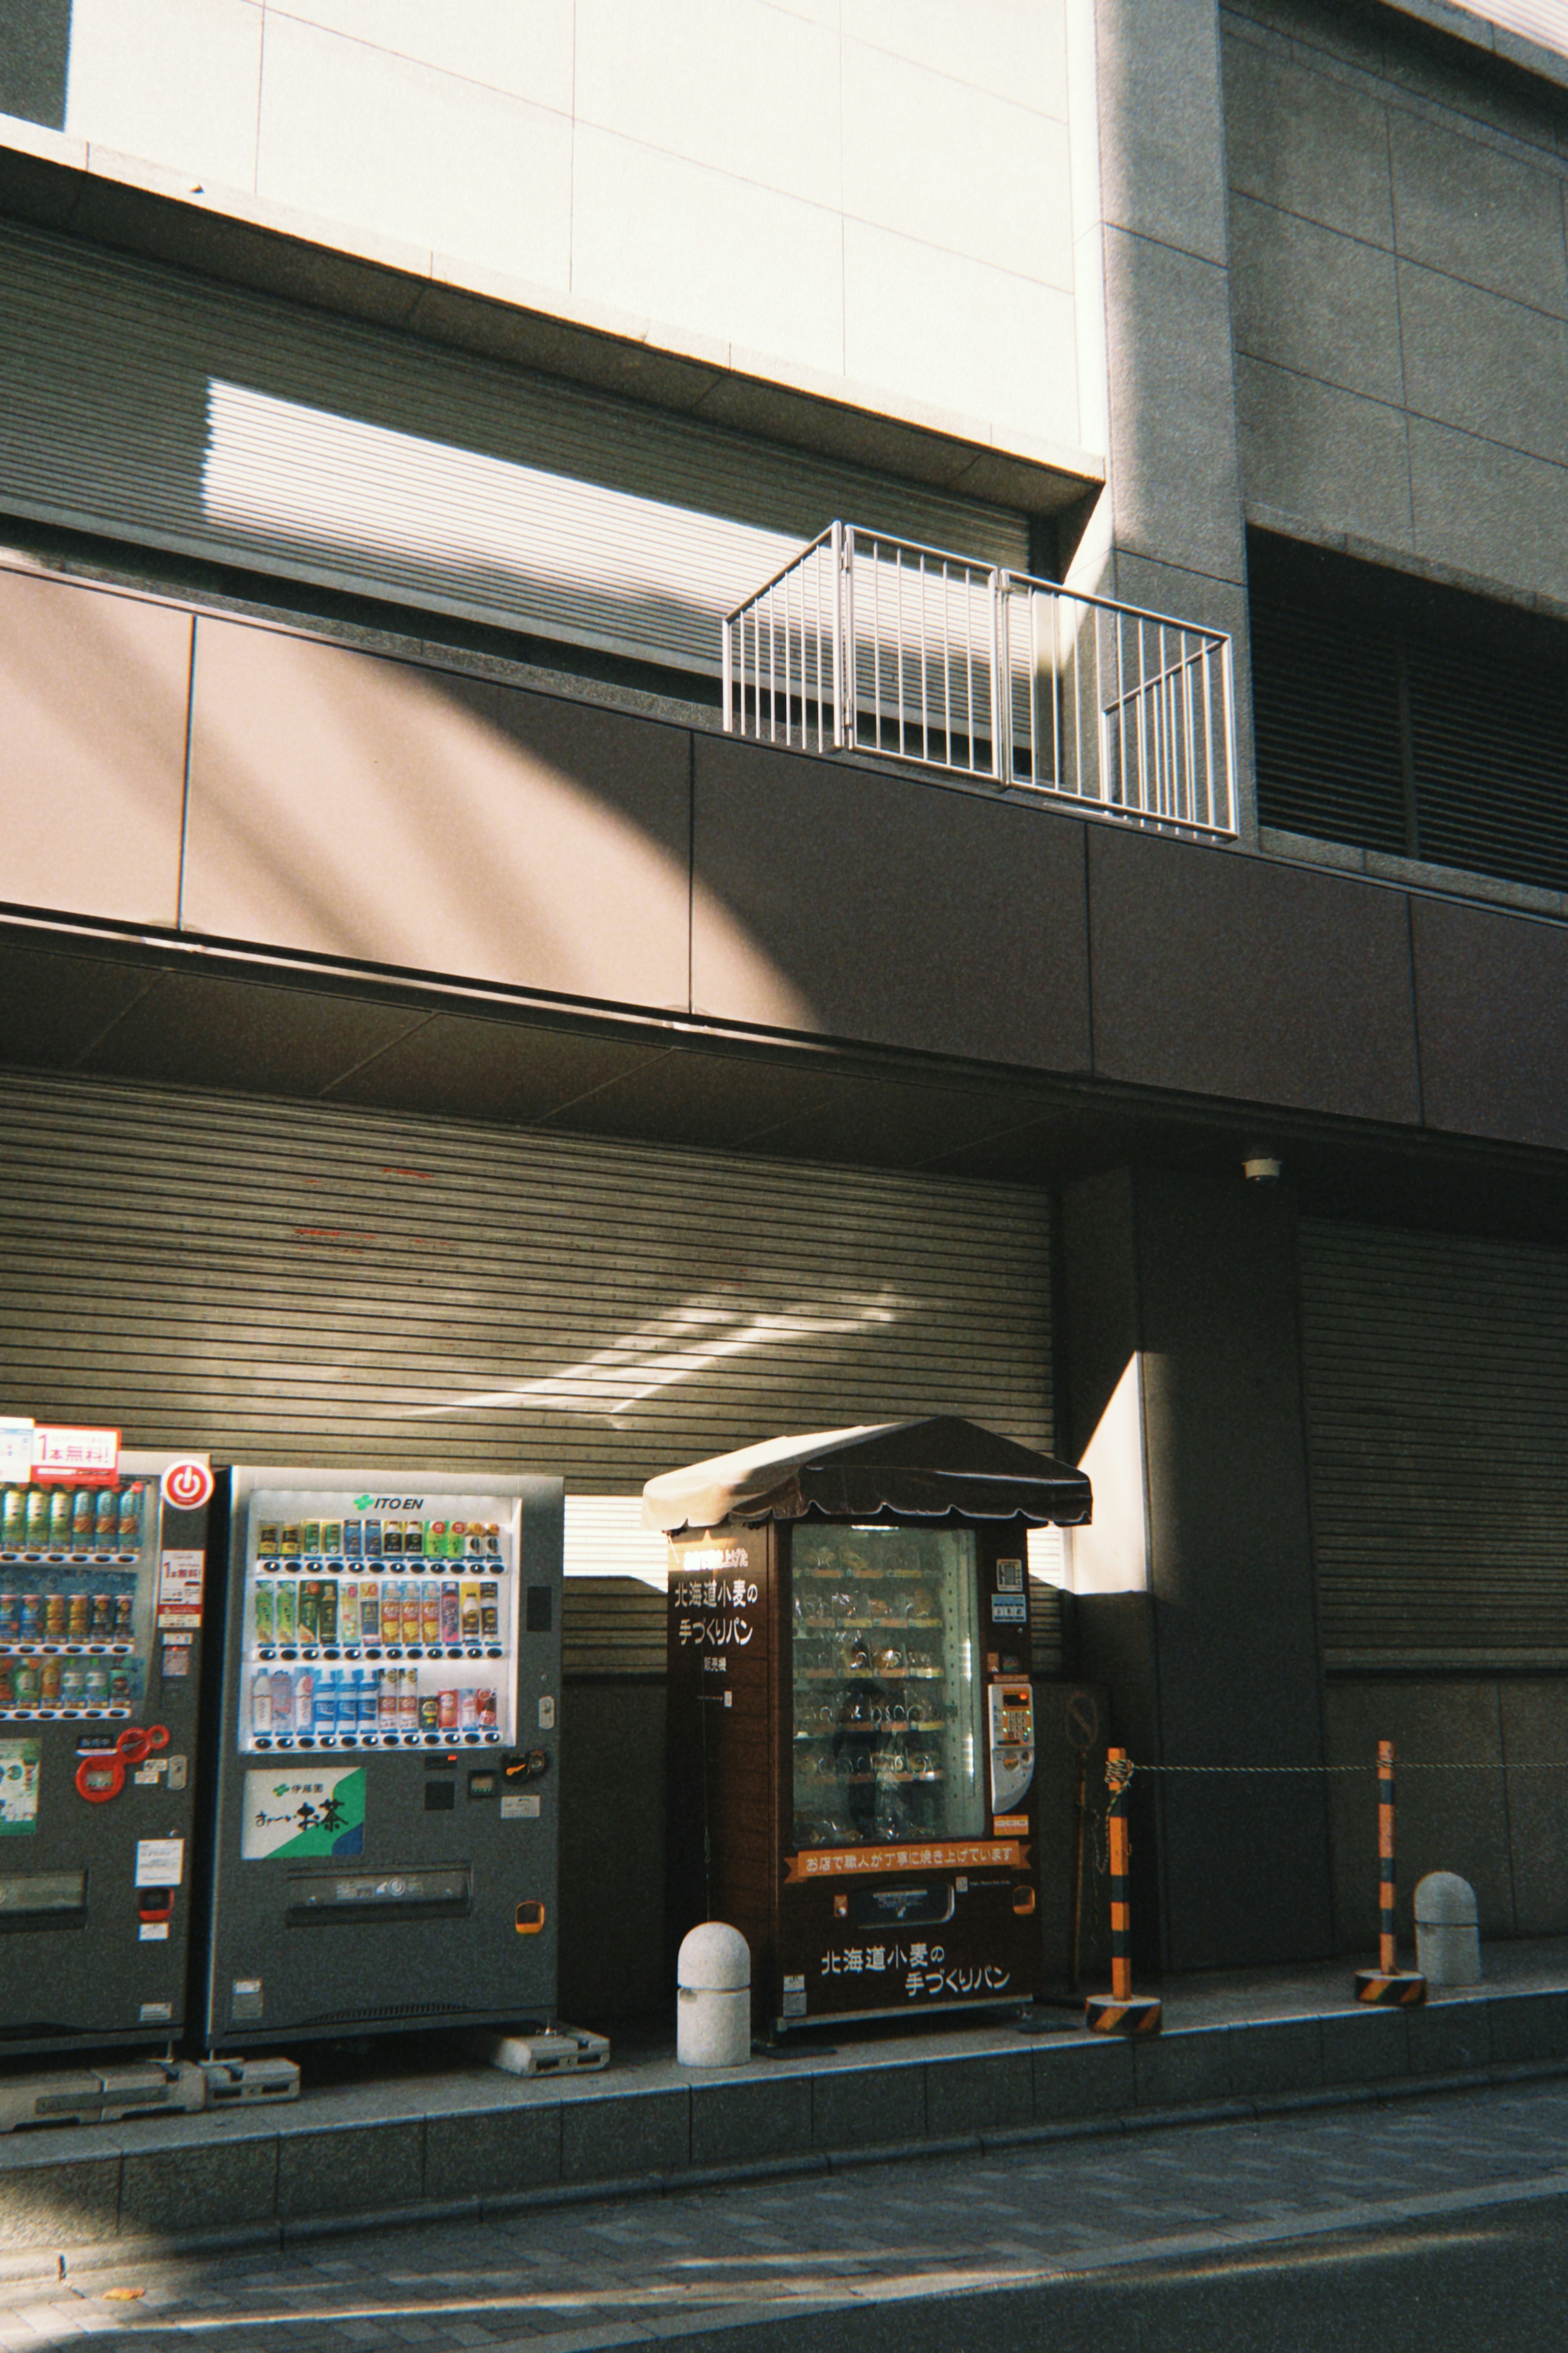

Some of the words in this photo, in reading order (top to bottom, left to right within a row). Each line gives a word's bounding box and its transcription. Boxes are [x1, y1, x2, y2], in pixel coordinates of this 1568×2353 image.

[374, 1497, 401, 1510] ITO
[402, 1498, 424, 1510] EN
[675, 1579, 758, 1608] 北海道小麦の
[679, 1616, 753, 1646] 手づくりパン
[704, 1656, 727, 1672] 販売機
[291, 1783, 323, 1794] 伊藤園
[806, 1847, 1013, 1872] お店で職人が丁寧に焼き上げています
[821, 1943, 945, 1975] 北海道小麦の
[905, 1965, 1011, 1997] 手づくりパン
